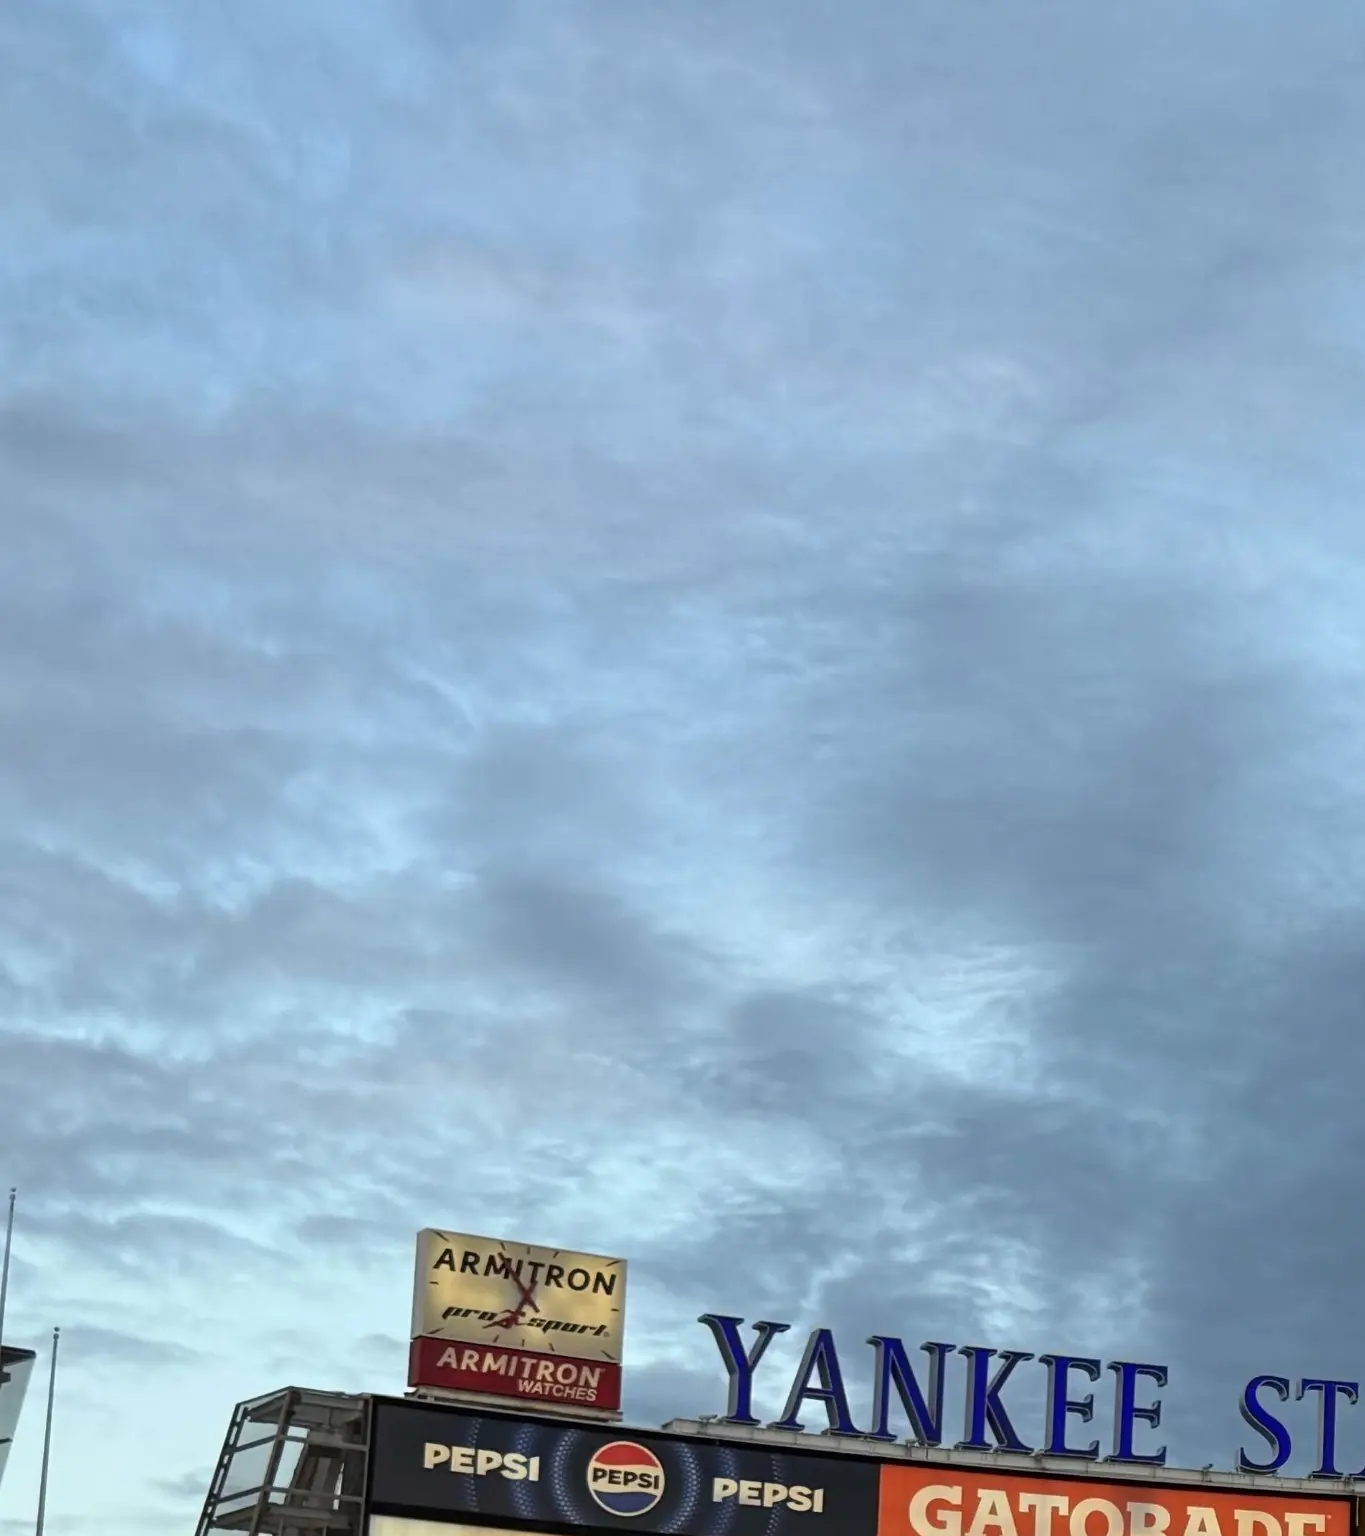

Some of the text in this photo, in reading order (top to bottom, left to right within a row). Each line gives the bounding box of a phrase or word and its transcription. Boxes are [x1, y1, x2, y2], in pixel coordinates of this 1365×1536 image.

[433, 1248, 617, 1296] ARMITRON
[436, 1346, 602, 1389] ARMITRON
[518, 1379, 598, 1402] WATCHES
[699, 1314, 1168, 1466] YANKEE
[423, 1442, 540, 1482] PEPSI
[591, 1467, 662, 1491] PEPSI
[712, 1477, 824, 1514] PEPSI
